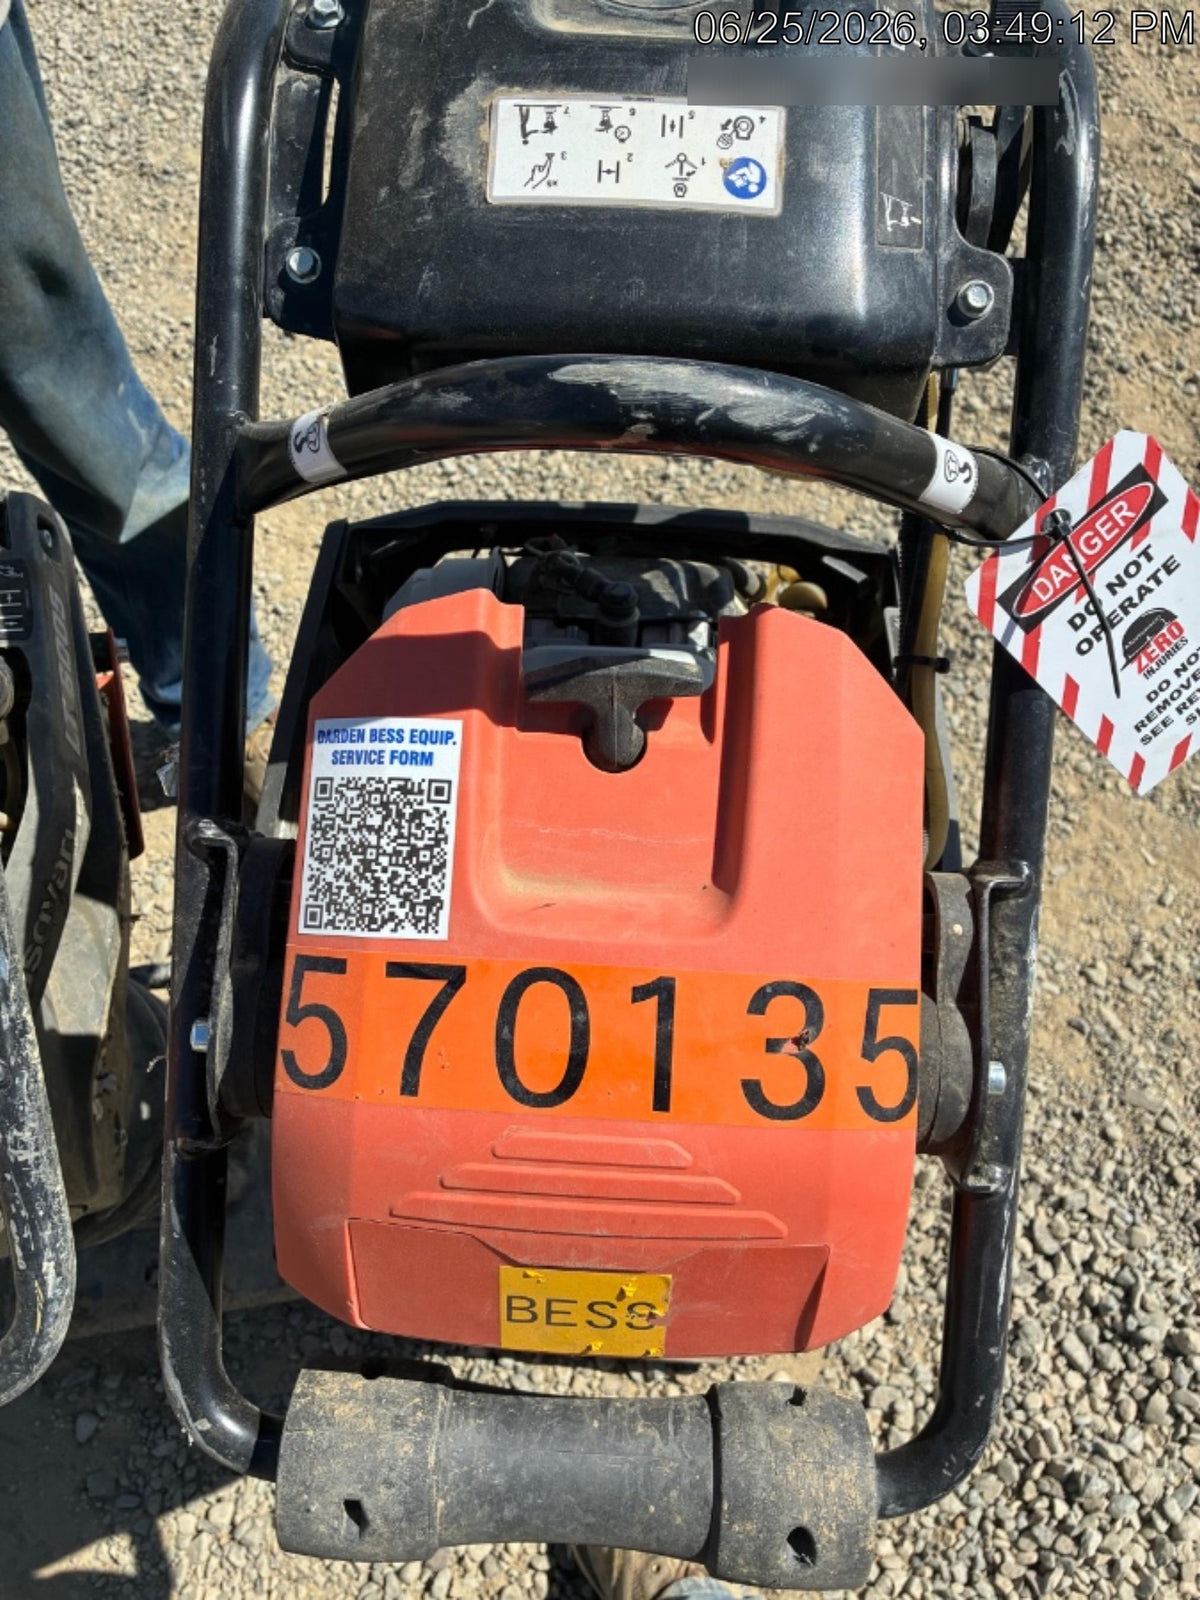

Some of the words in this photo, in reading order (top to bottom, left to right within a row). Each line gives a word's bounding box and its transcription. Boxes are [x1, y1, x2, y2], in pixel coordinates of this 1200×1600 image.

[1032, 500, 1137, 602] DANGER
[1066, 597, 1103, 633] DO
[1105, 543, 1155, 597] NOT
[1075, 554, 1182, 657] OPERATE
[1130, 620, 1185, 676] ZERO
[1142, 635, 1189, 681] INJURIES
[1145, 678, 1172, 703] DO
[1173, 646, 1200, 678] NO
[317, 727, 366, 744] DARDEN
[368, 727, 405, 744] BESS
[409, 728, 458, 746] EQUIP.
[1139, 714, 1175, 746] SEE
[1174, 687, 1200, 715] RE
[331, 749, 387, 766] SERVICE
[388, 749, 434, 766] FORM
[281, 953, 920, 1122] 570135
[506, 1294, 658, 1331] BESS
